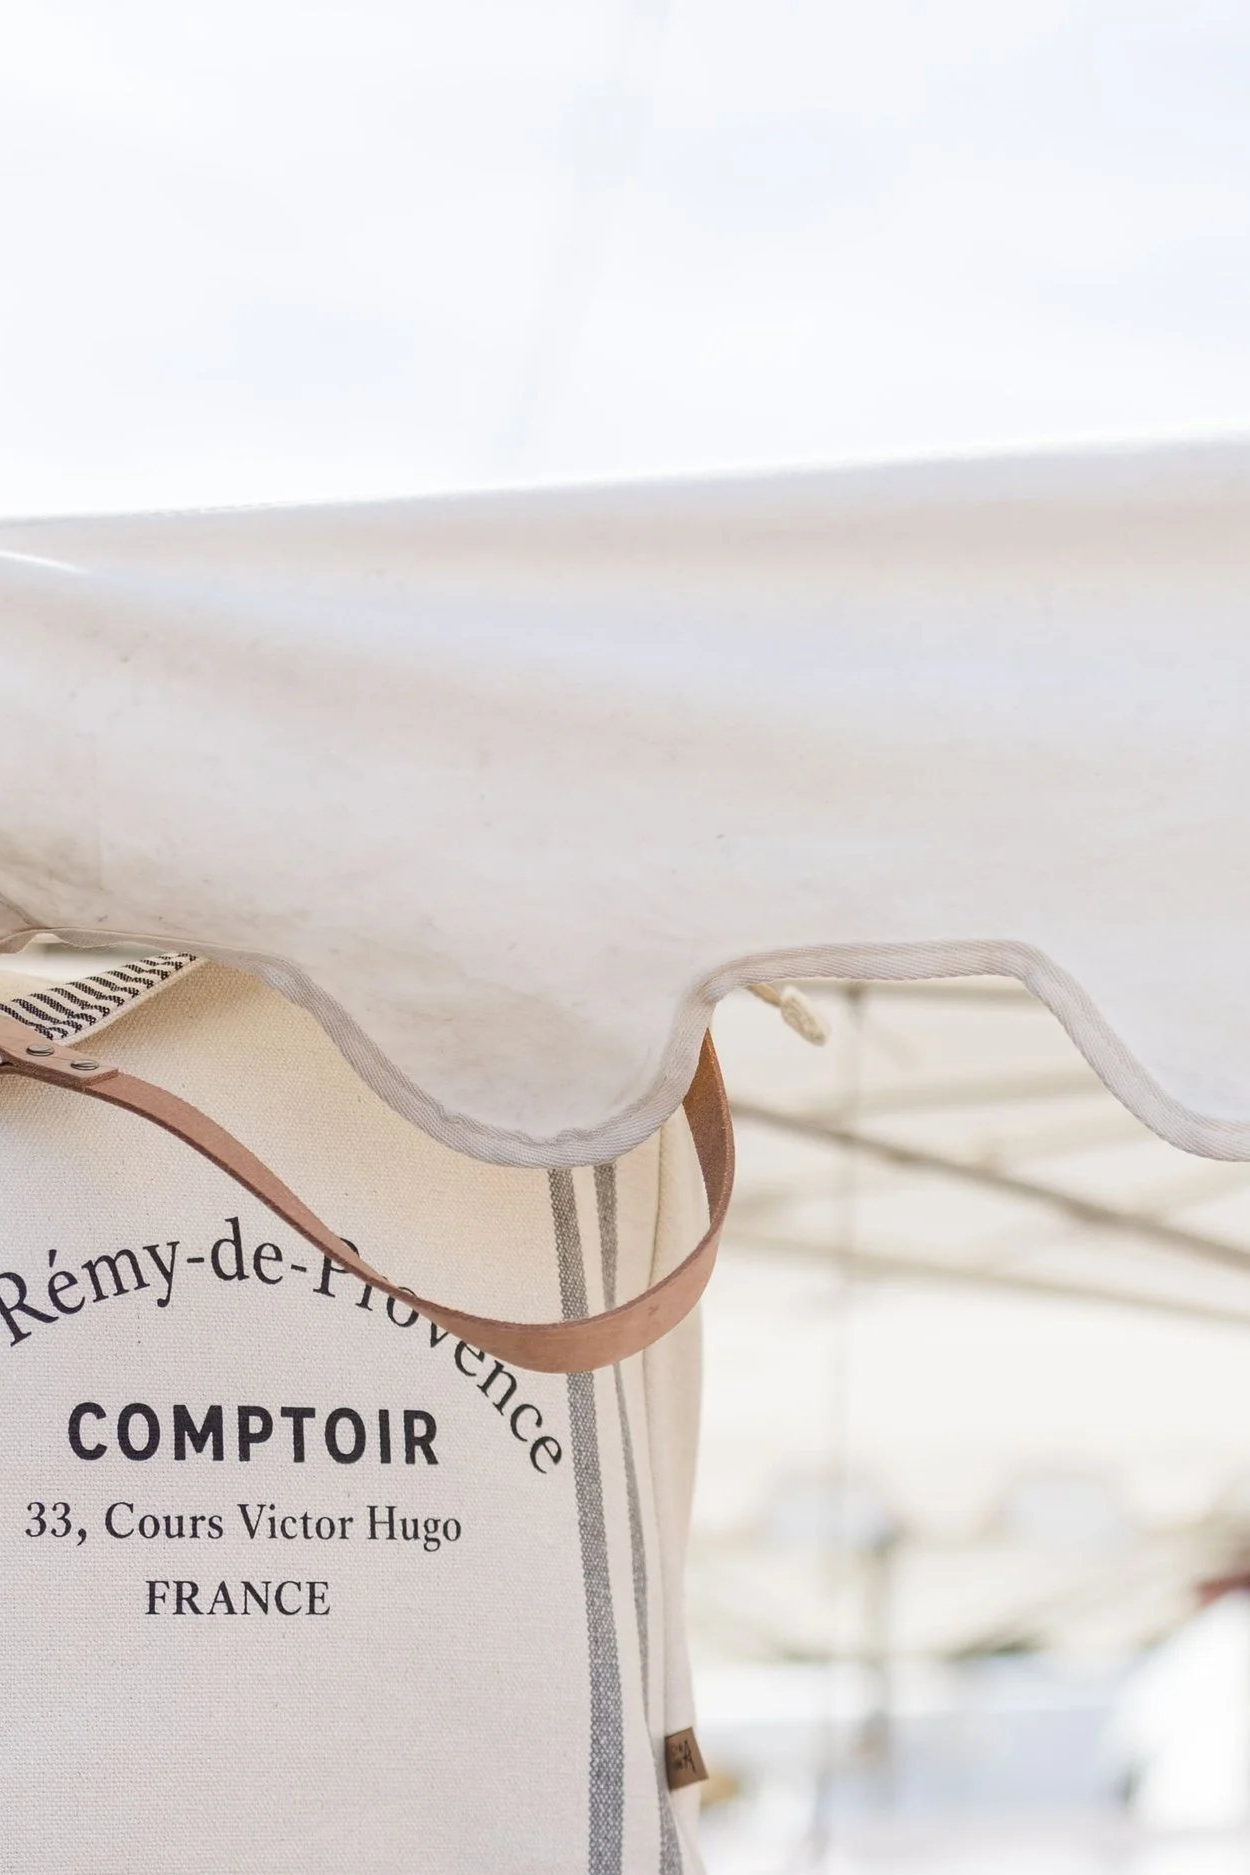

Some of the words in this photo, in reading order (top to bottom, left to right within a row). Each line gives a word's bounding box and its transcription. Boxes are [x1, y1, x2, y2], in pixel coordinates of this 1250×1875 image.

[67, 1401, 440, 1466] COMPTOIR
[24, 1501, 88, 1547] 33,
[104, 1501, 225, 1540] Cours
[237, 1503, 355, 1541] Victor
[366, 1505, 463, 1553] Hugo
[144, 1580, 331, 1617] FRANCE
